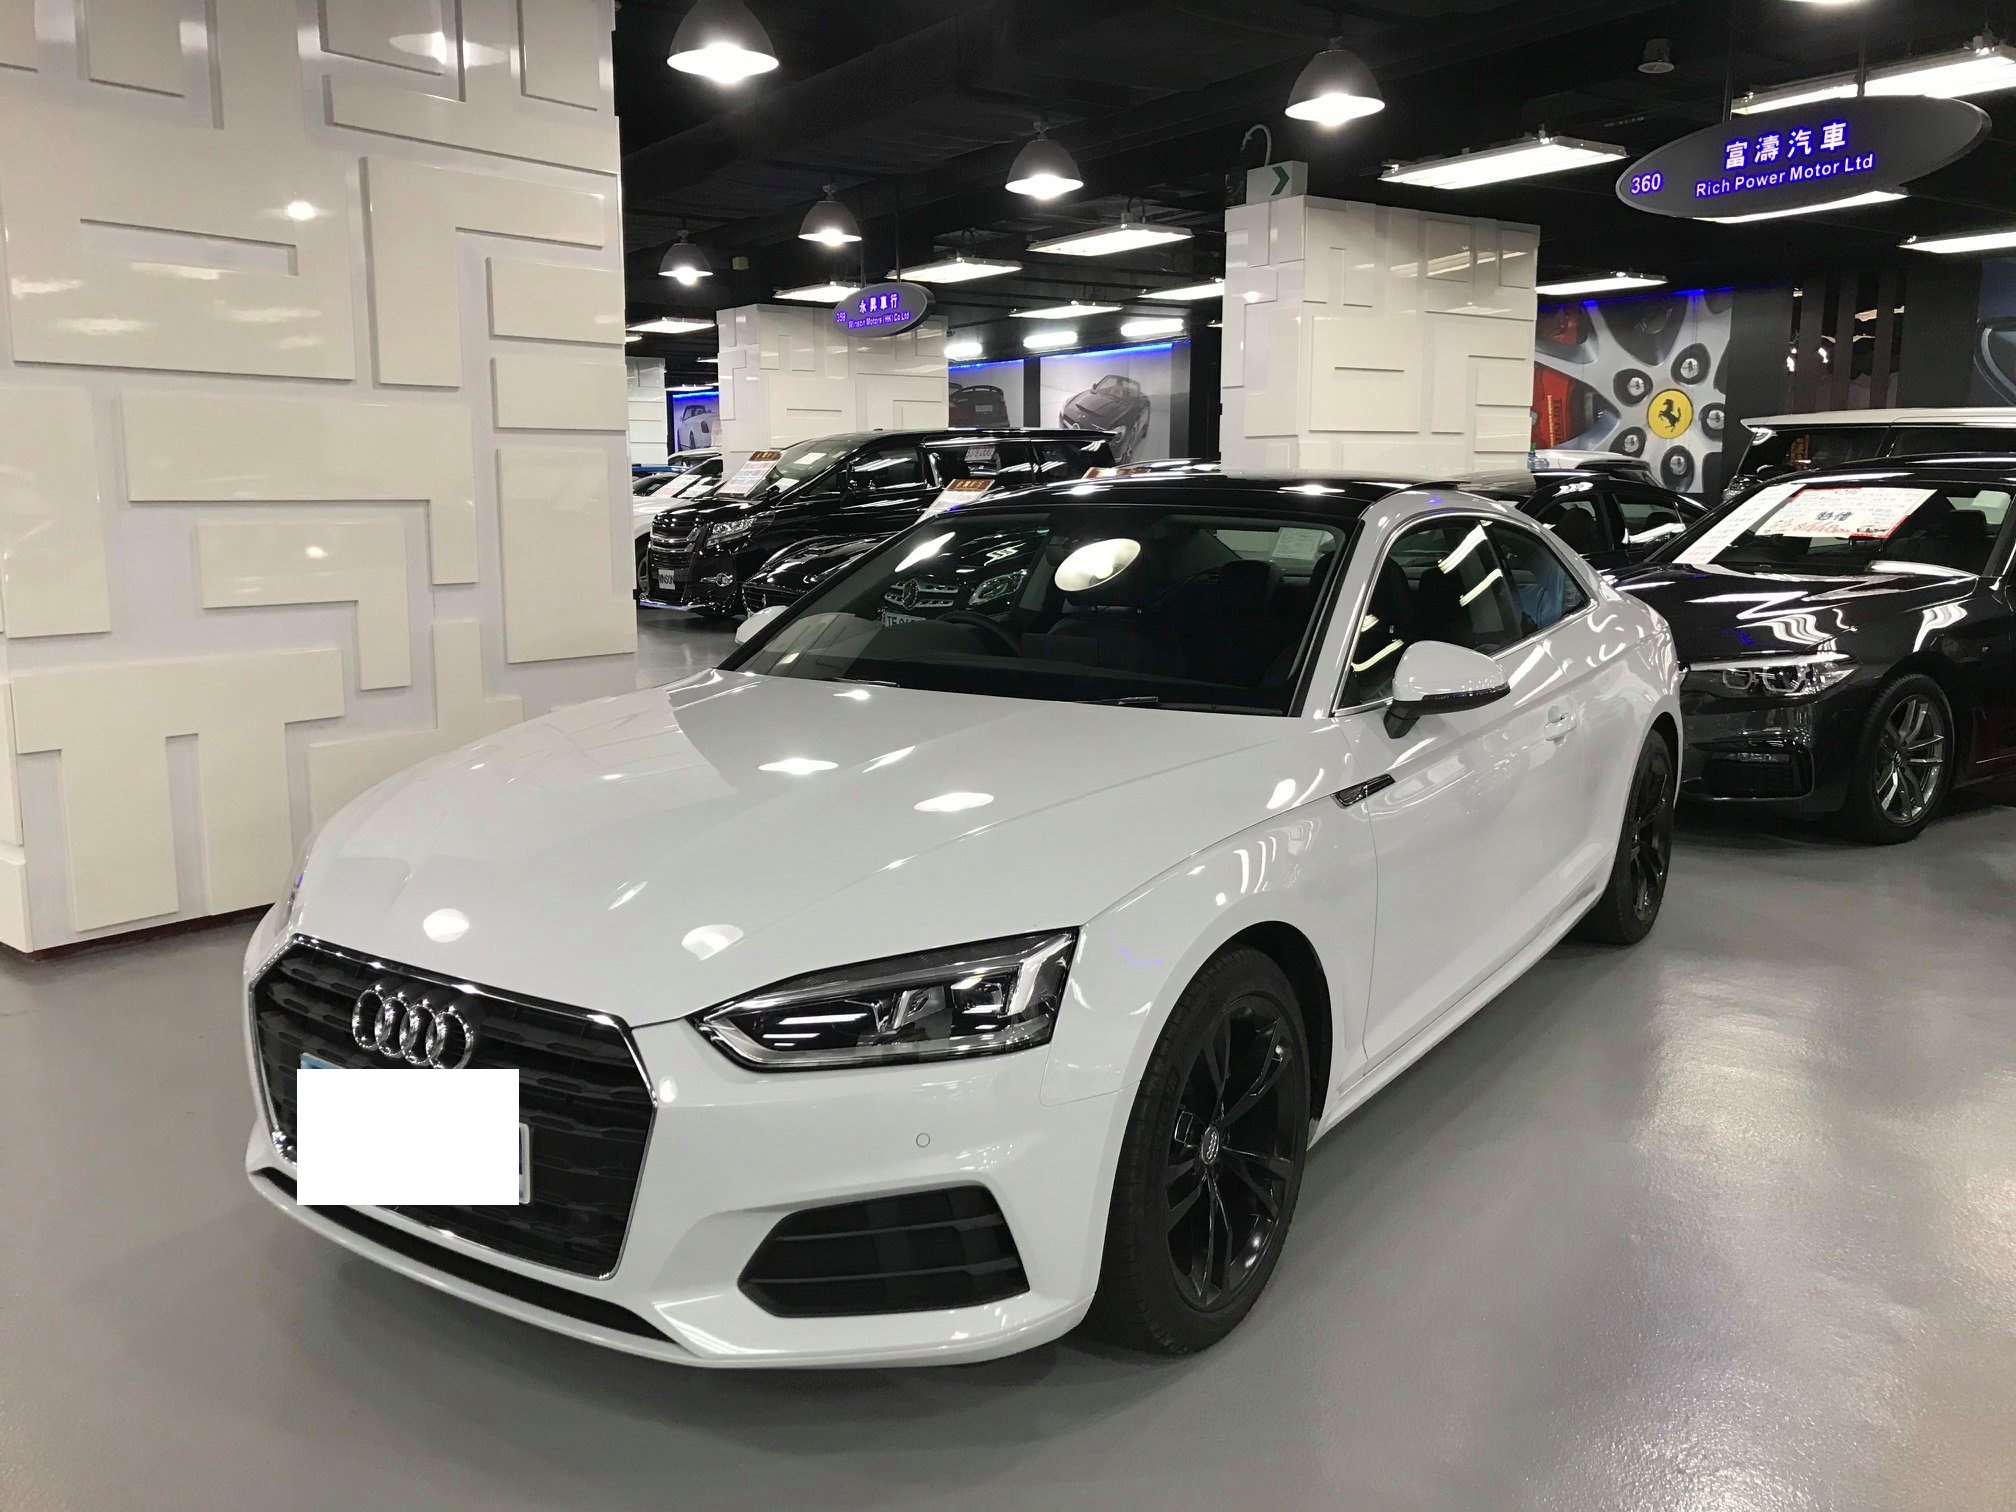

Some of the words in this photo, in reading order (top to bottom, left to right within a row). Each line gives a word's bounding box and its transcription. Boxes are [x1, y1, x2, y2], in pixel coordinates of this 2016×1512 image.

[1725, 122, 1847, 170] 富濤汽車
[1631, 173, 1661, 194] 360
[1696, 179, 1730, 198] Rich
[1734, 171, 1786, 191] Power
[1789, 161, 1840, 181] Motor
[1844, 153, 1874, 173] Ltd
